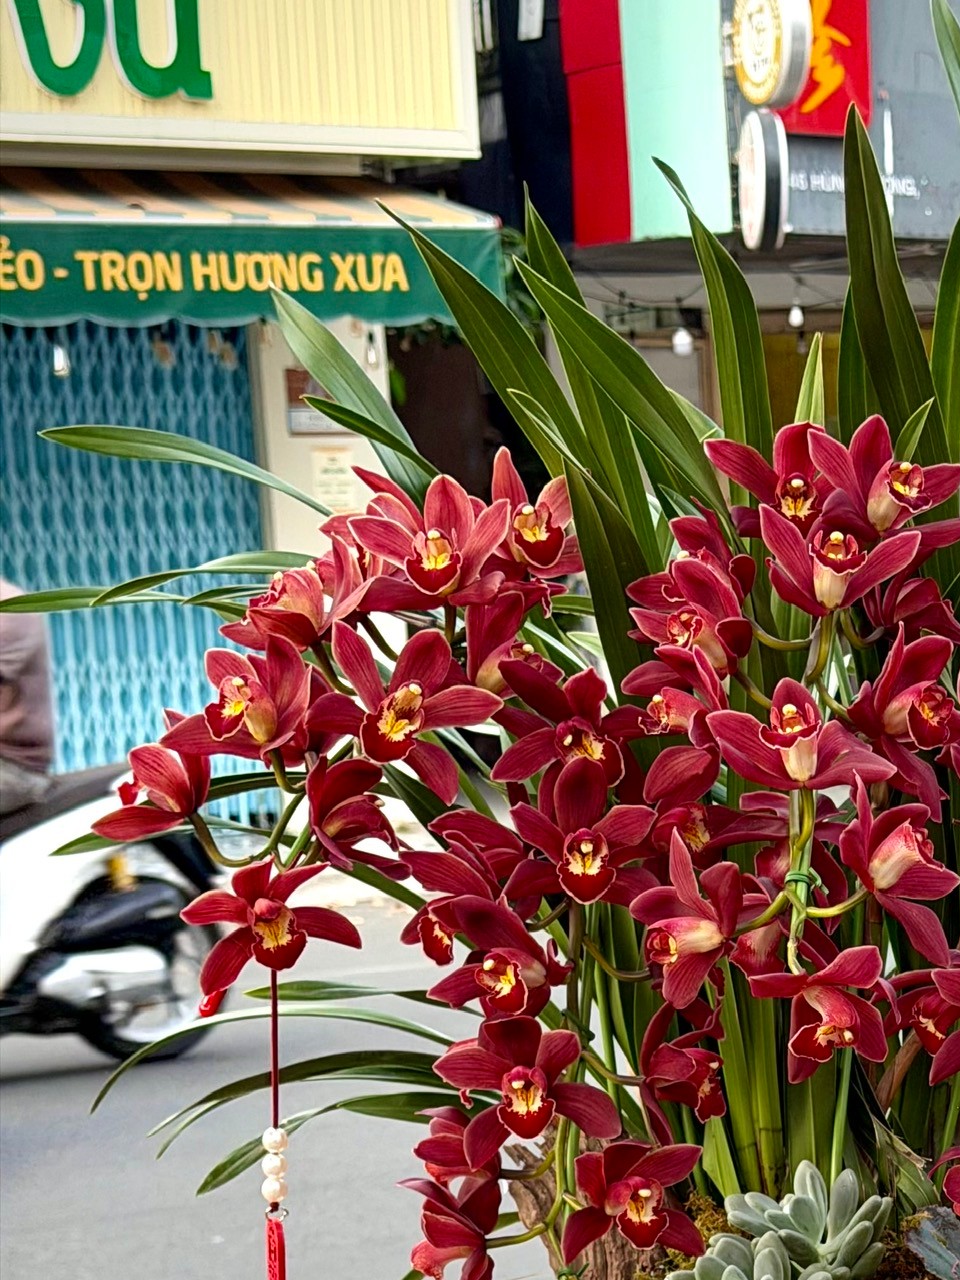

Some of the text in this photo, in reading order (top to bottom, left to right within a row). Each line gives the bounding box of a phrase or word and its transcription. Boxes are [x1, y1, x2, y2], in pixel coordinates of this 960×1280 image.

[74, 249, 182, 301] TRỌN
[190, 250, 325, 293] HƯƠNG
[330, 252, 409, 293] XƯA
